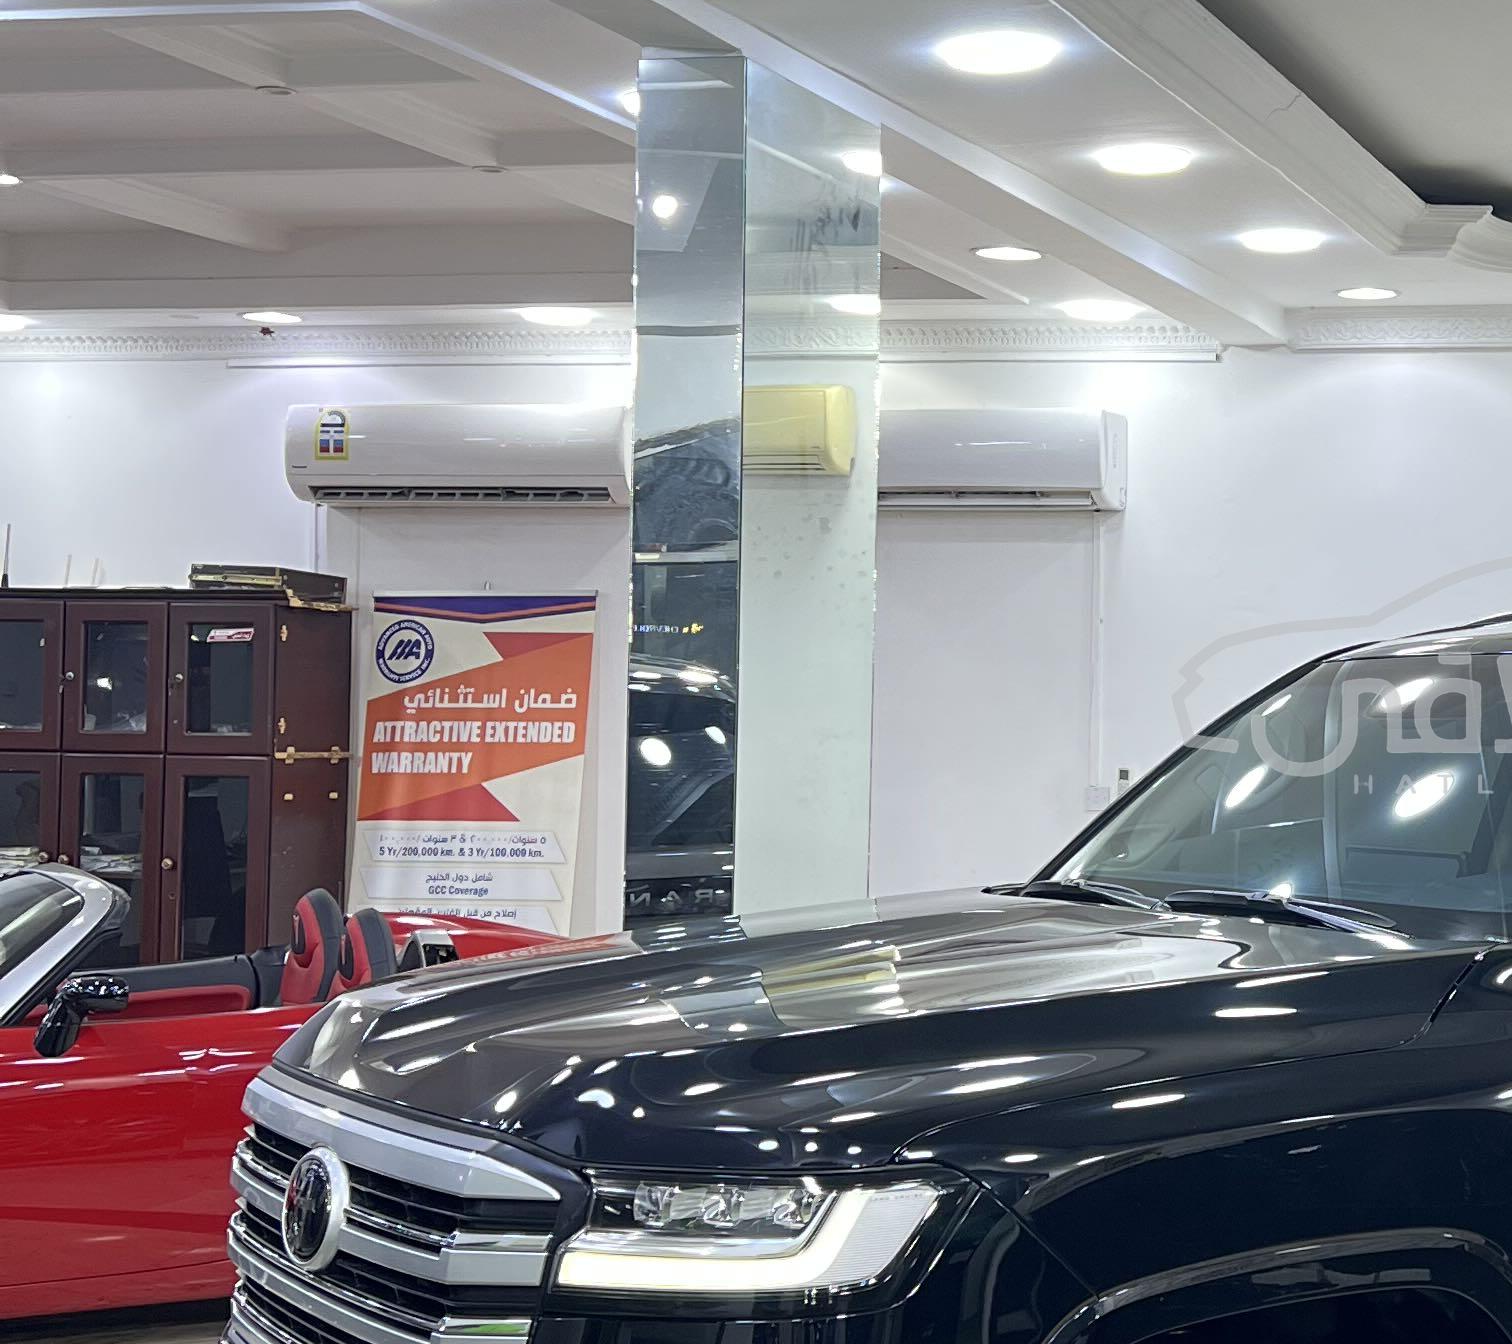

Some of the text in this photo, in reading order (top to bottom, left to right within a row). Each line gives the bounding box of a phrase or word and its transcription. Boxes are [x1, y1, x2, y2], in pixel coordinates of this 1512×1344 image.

[404, 684, 577, 714] ضمان استثنائي
[372, 721, 577, 743] ATTRACTIVE EXTENDED
[371, 752, 473, 774] WARRANTY
[379, 846, 385, 856] 5
[467, 848, 474, 857] 3
[428, 886, 489, 897] GCC Coverage
